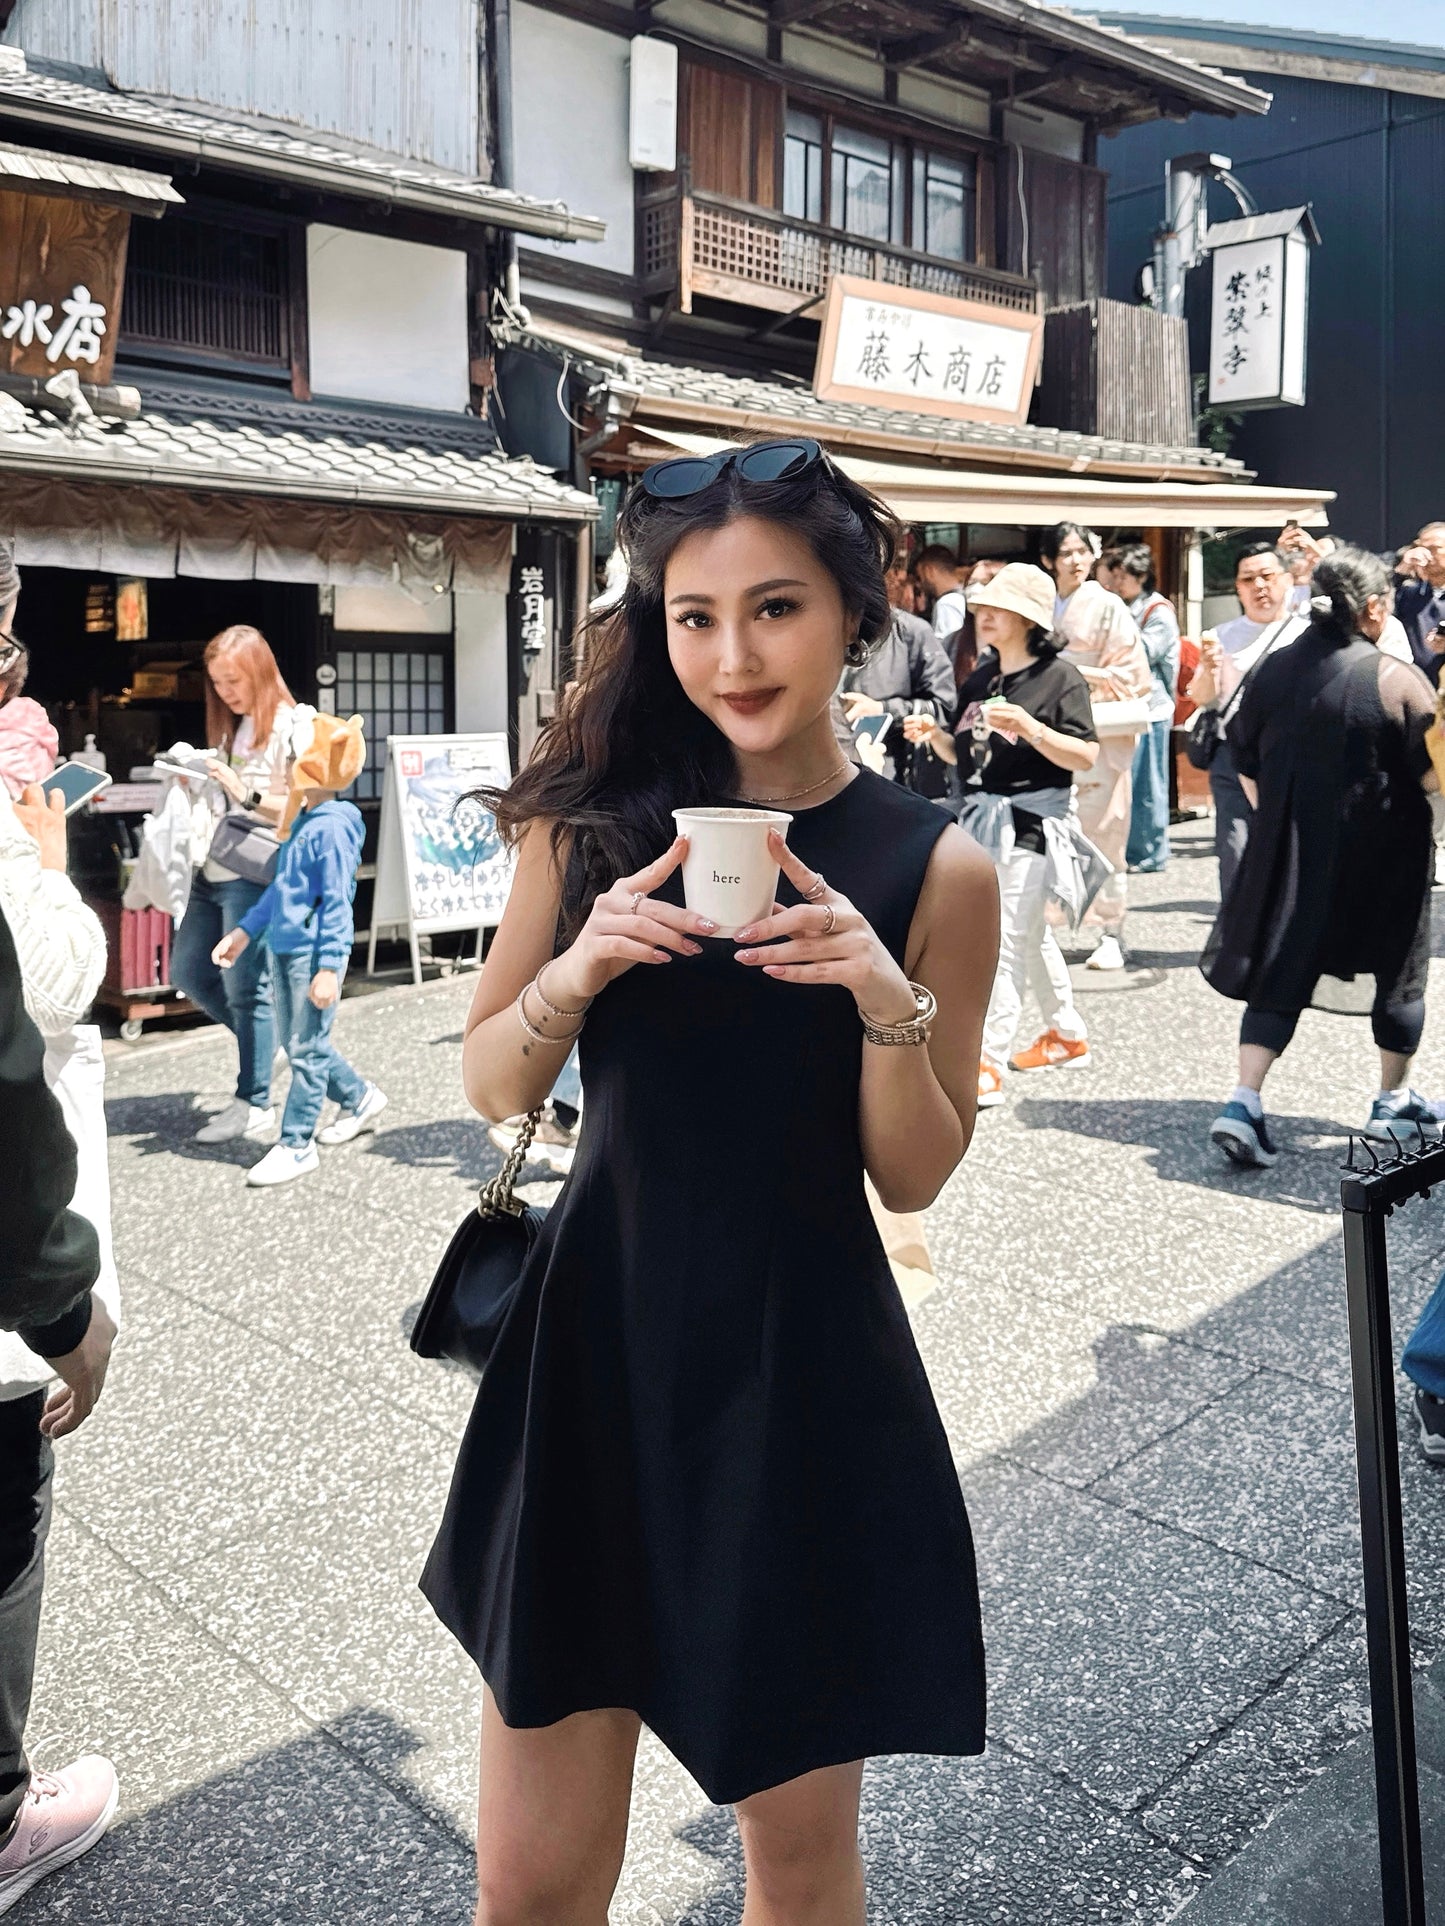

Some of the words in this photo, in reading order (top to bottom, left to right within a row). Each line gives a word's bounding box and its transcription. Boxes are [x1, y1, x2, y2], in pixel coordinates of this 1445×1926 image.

[856, 330, 1007, 396] 藤木商店
[518, 565, 547, 650] 岩月堂
[712, 870, 741, 884] here
